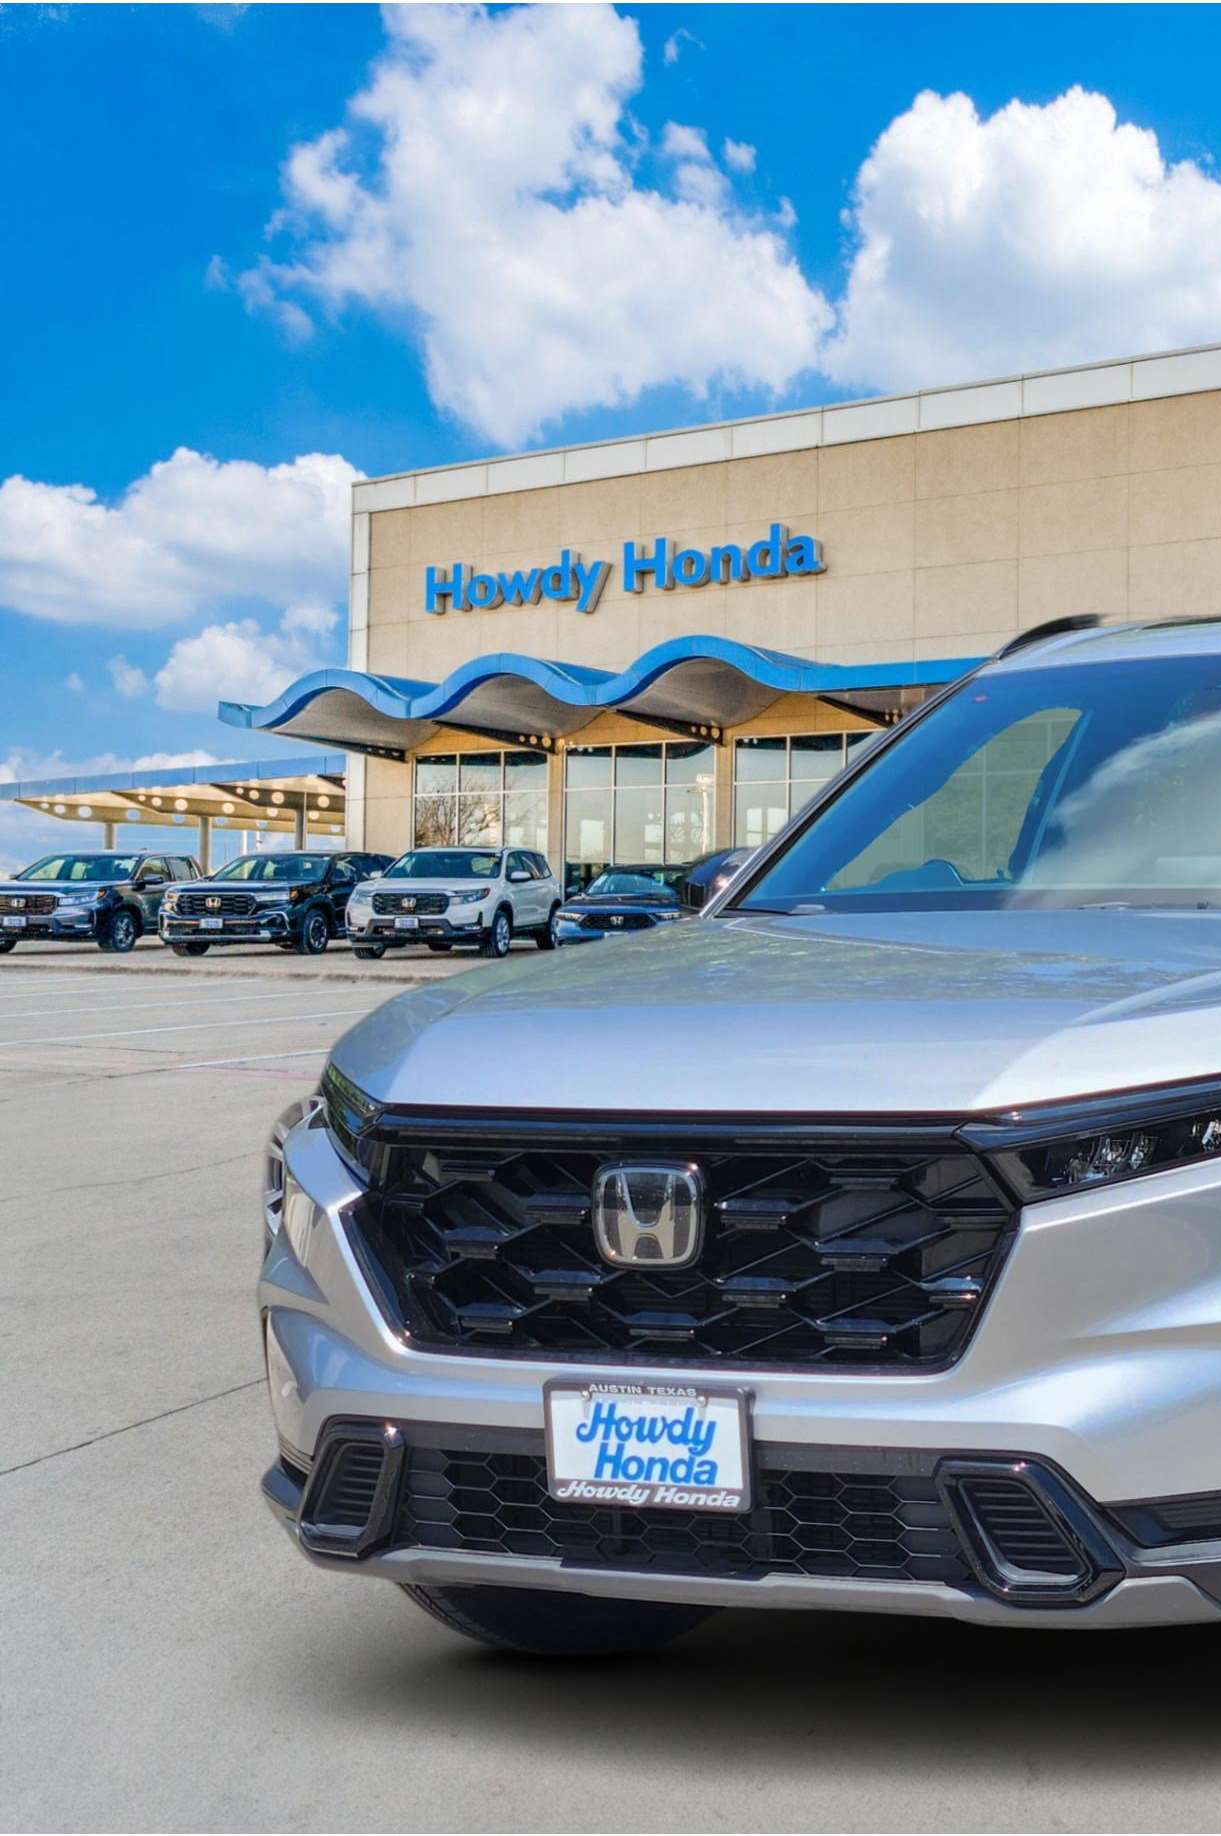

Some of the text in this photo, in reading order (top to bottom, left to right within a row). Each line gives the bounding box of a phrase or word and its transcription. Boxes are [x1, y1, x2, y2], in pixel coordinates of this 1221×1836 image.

[425, 523, 827, 615] Howdy Honda
[588, 1383, 697, 1397] AUSTIN TEXAS
[576, 1402, 717, 1456] Howdy
[594, 1442, 718, 1485] Honda
[556, 1481, 741, 1508] Howdy Honda
